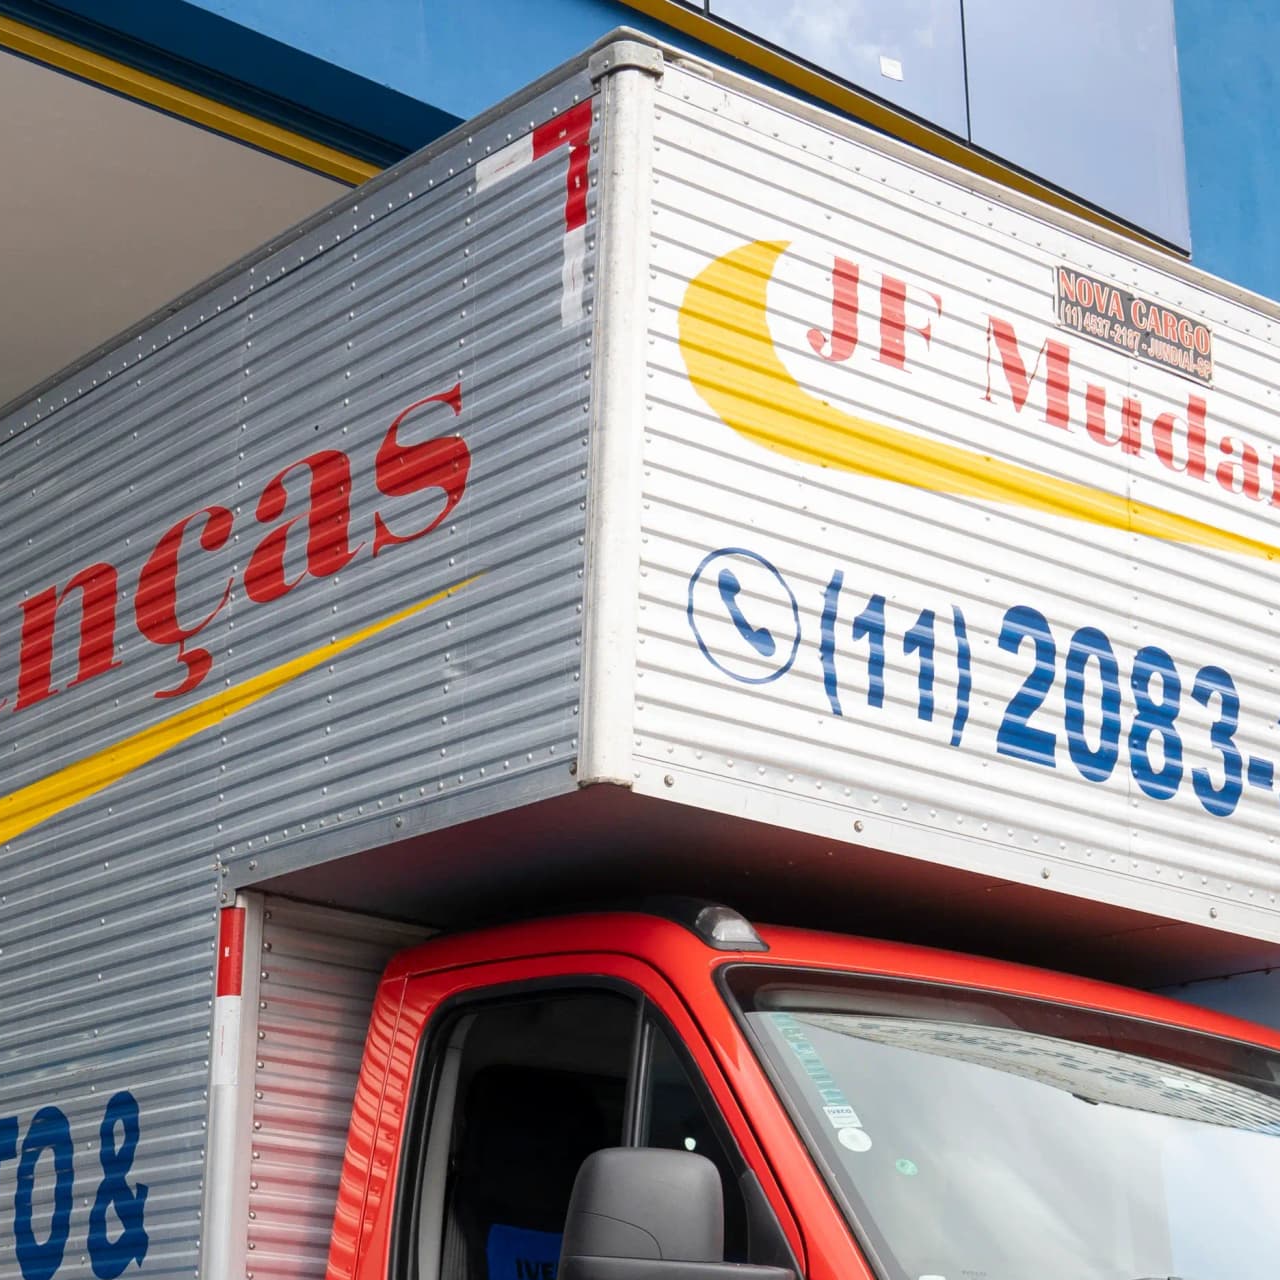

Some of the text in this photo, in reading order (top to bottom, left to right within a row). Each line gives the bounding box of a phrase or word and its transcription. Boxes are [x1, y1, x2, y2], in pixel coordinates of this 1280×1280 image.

[806, 255, 942, 374] JF
[1059, 269, 1211, 355] NOVA CARGO
[820, 570, 972, 748] (11)
